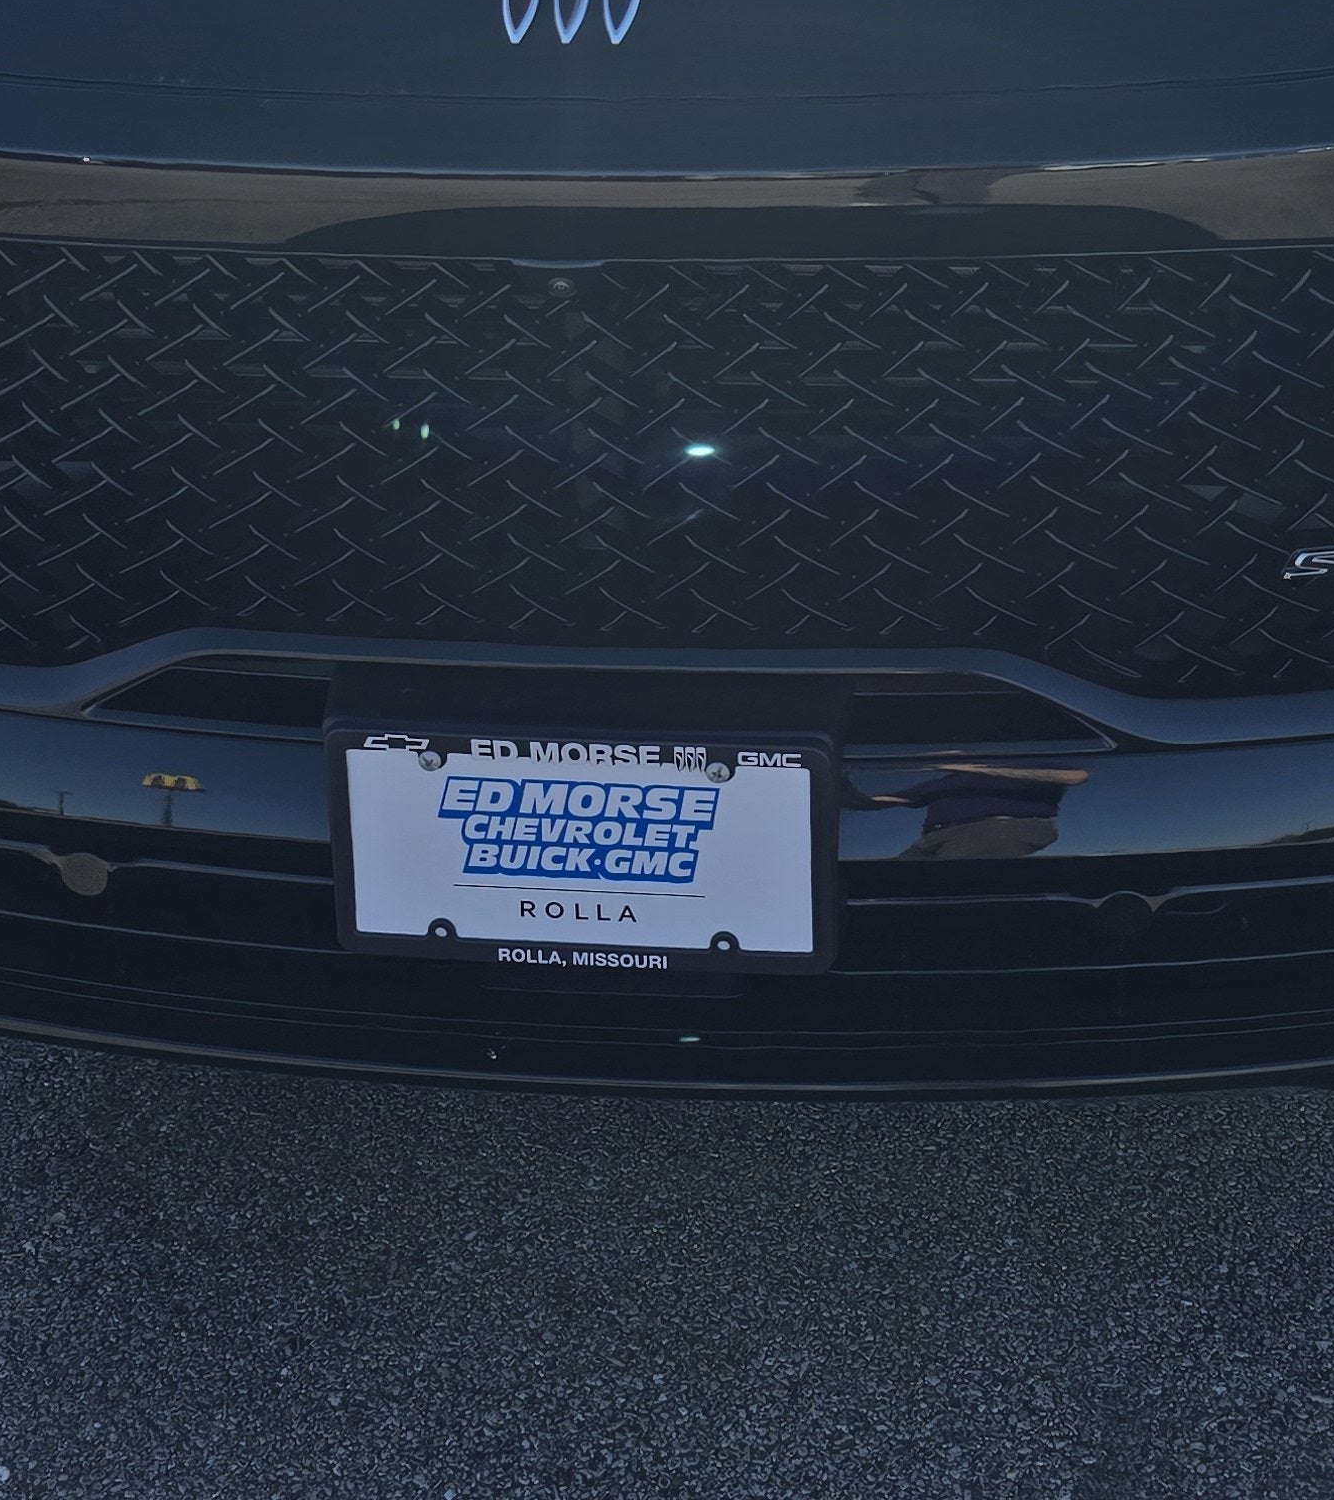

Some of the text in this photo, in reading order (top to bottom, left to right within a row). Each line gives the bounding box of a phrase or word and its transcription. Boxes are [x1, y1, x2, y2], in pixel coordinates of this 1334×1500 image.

[470, 738, 661, 767] ED MORSE
[737, 751, 802, 767] GMC
[441, 779, 717, 822] ED MORSE
[464, 814, 696, 848] CHEVROLET
[520, 900, 637, 923] ROLLA
[498, 948, 668, 970] ROLLA, MISSOURI
